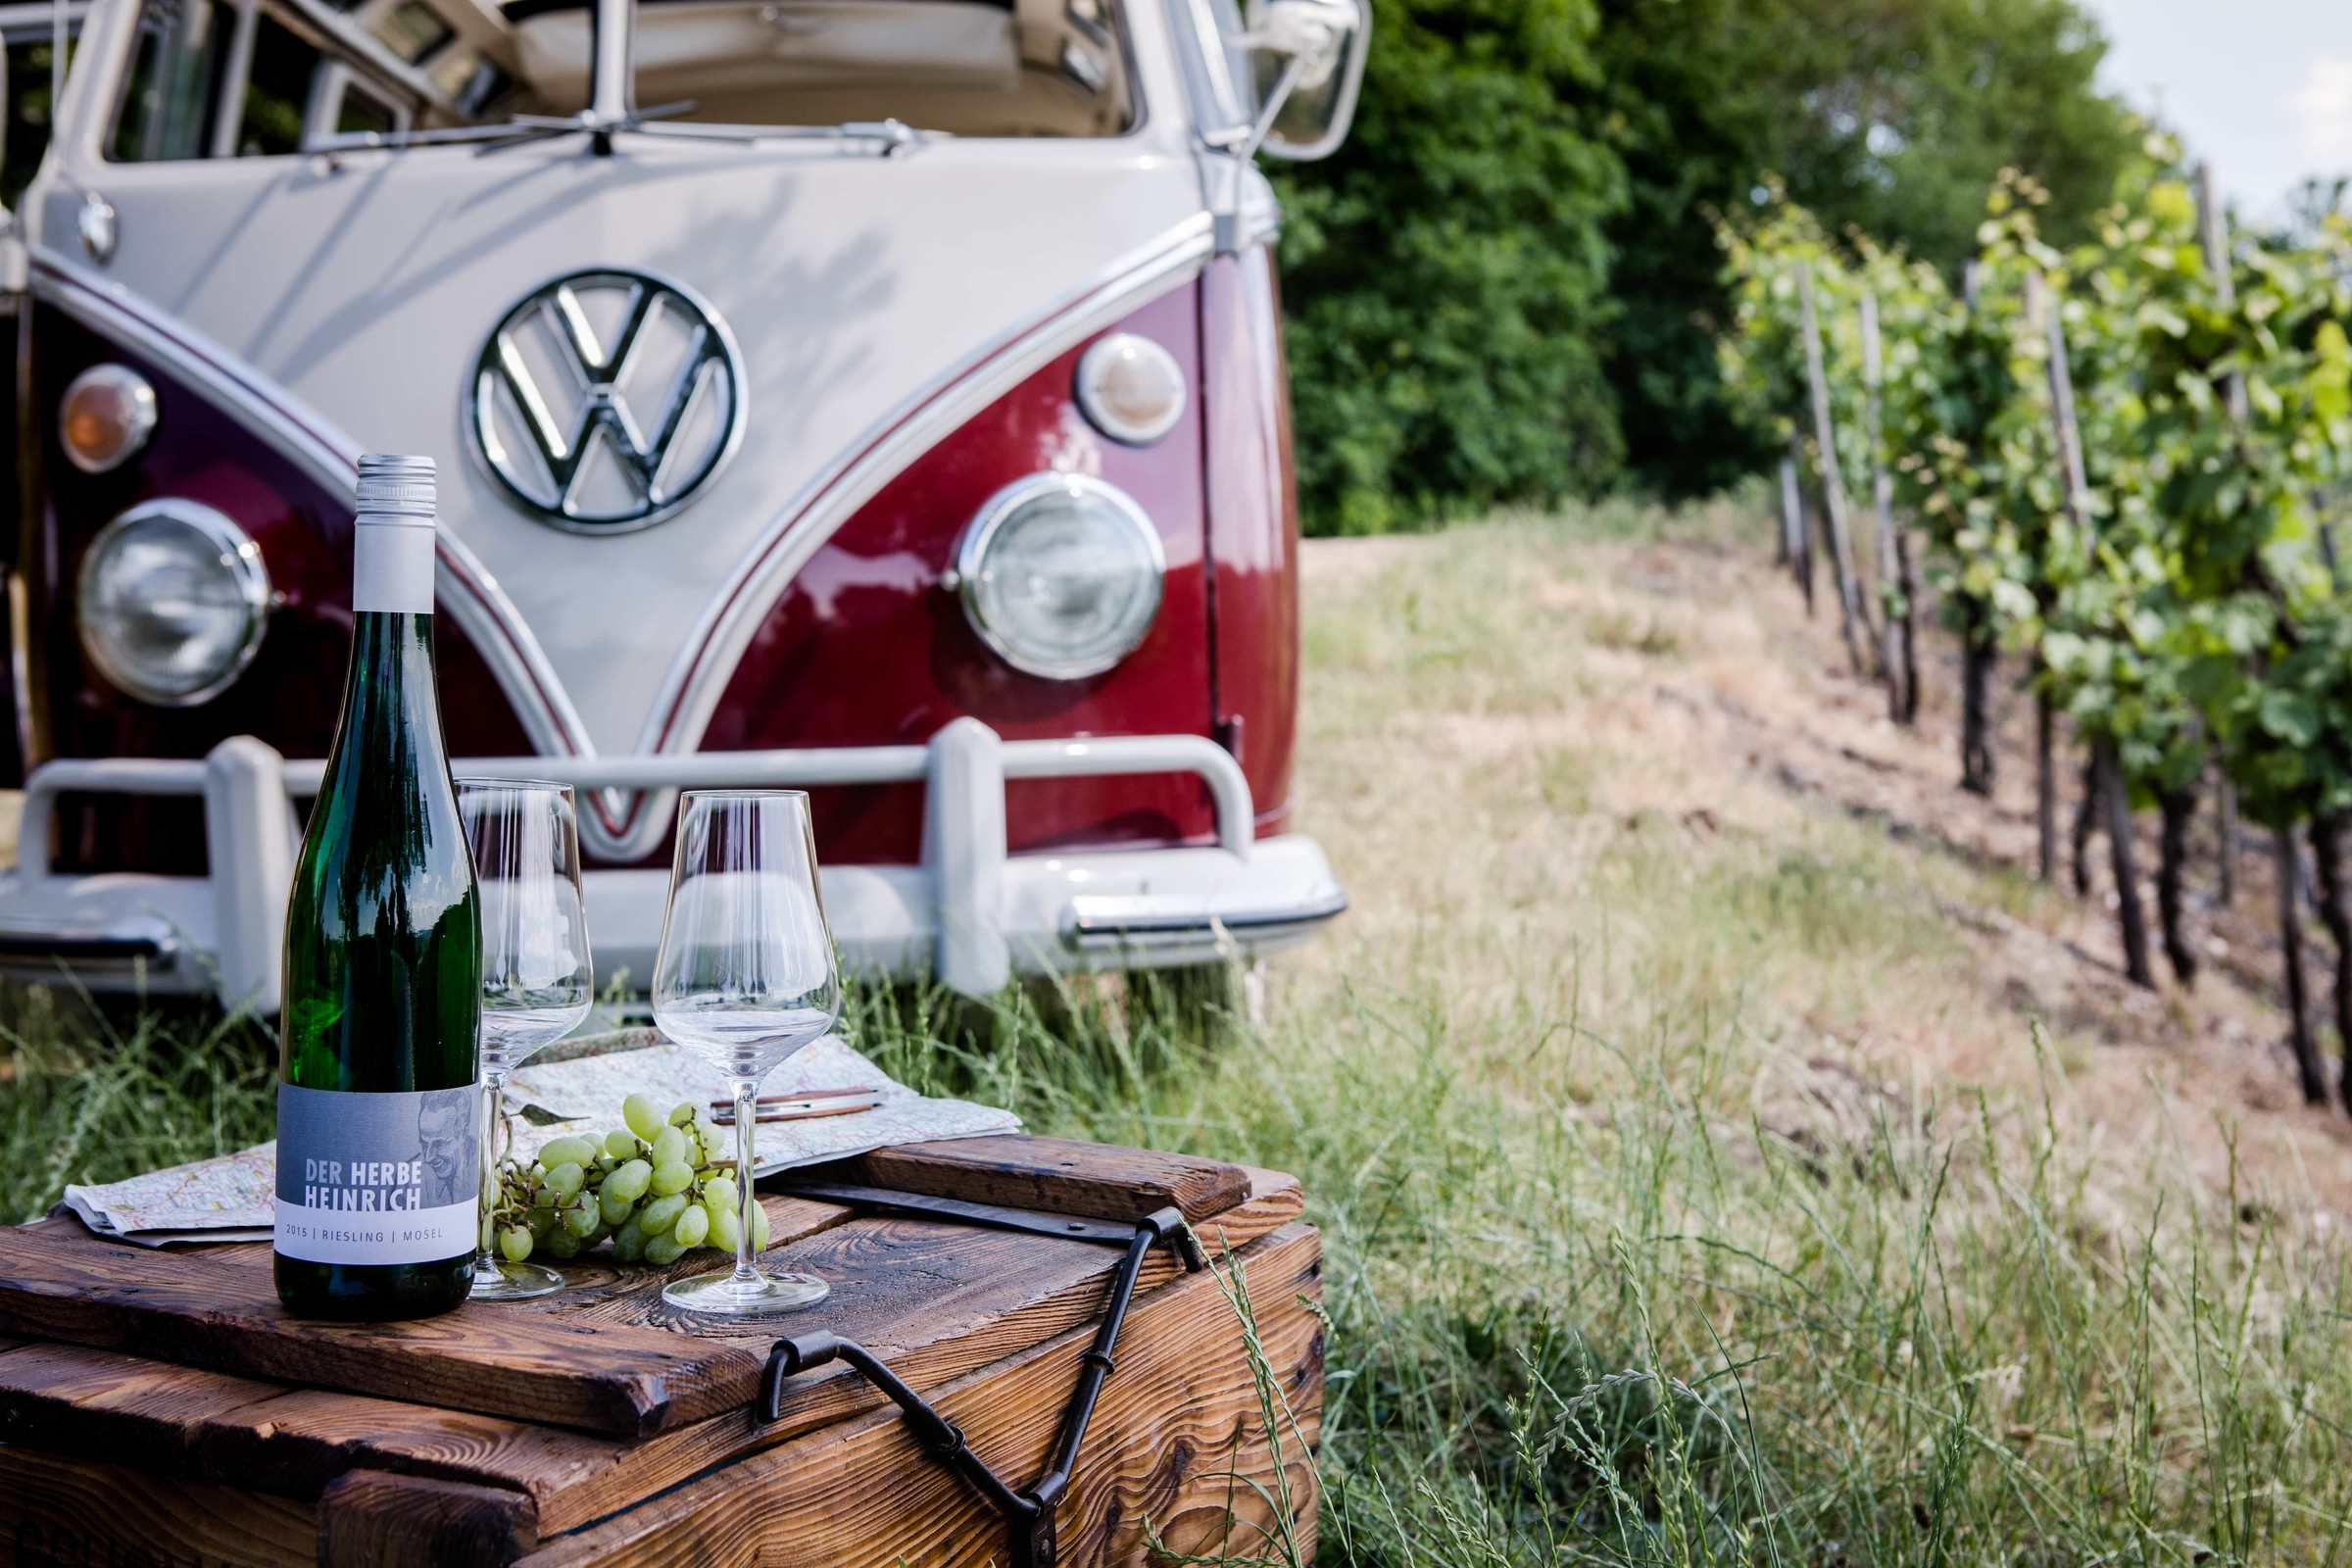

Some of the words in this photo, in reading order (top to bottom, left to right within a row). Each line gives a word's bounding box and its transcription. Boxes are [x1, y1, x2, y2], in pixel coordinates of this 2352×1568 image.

[470, 272, 736, 523] VW
[306, 1158, 342, 1185] DER
[351, 1161, 421, 1186] HERBE
[305, 1185, 420, 1212] HEINRICH
[286, 1224, 308, 1238] 2015
[321, 1230, 384, 1243] RIESLING
[403, 1228, 443, 1242] MOSEL
